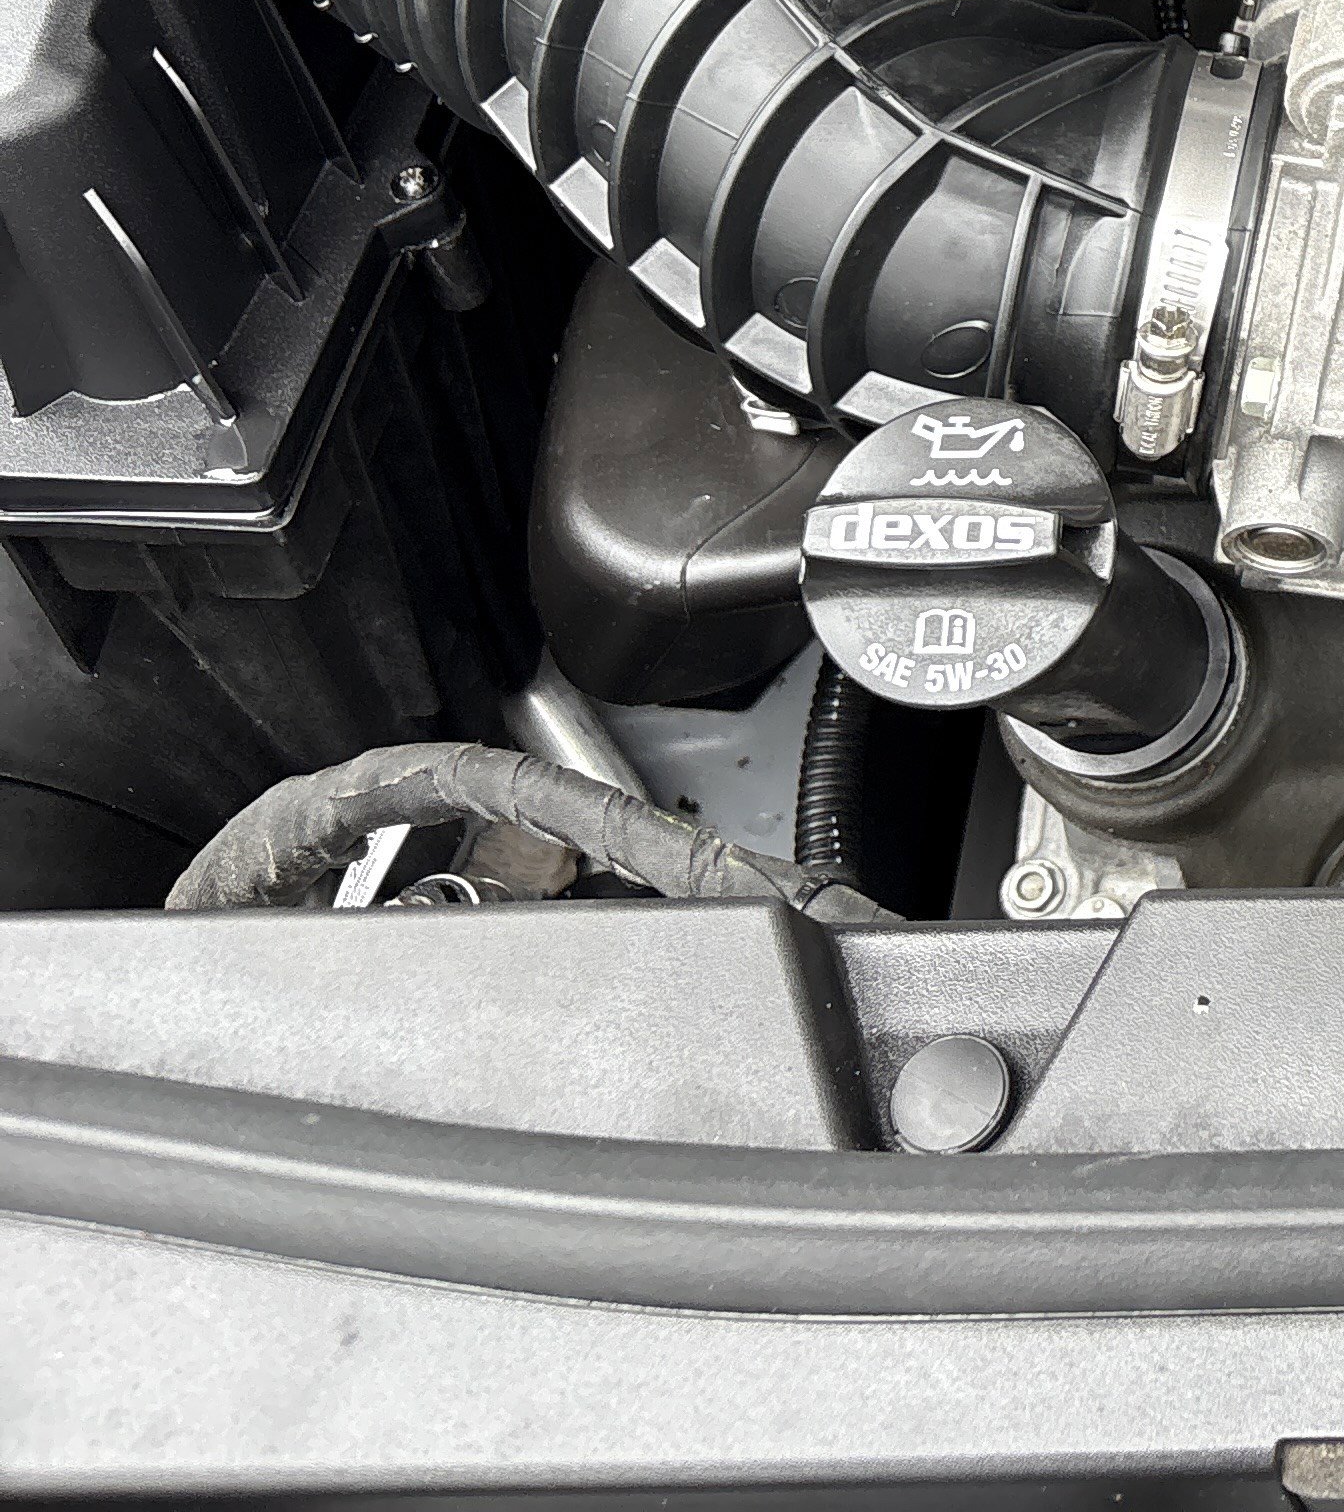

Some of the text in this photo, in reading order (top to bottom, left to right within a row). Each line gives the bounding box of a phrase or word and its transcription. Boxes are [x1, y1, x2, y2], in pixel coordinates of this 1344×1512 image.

[829, 503, 1036, 551] dexos
[859, 642, 1028, 692] SAE 5W-30
